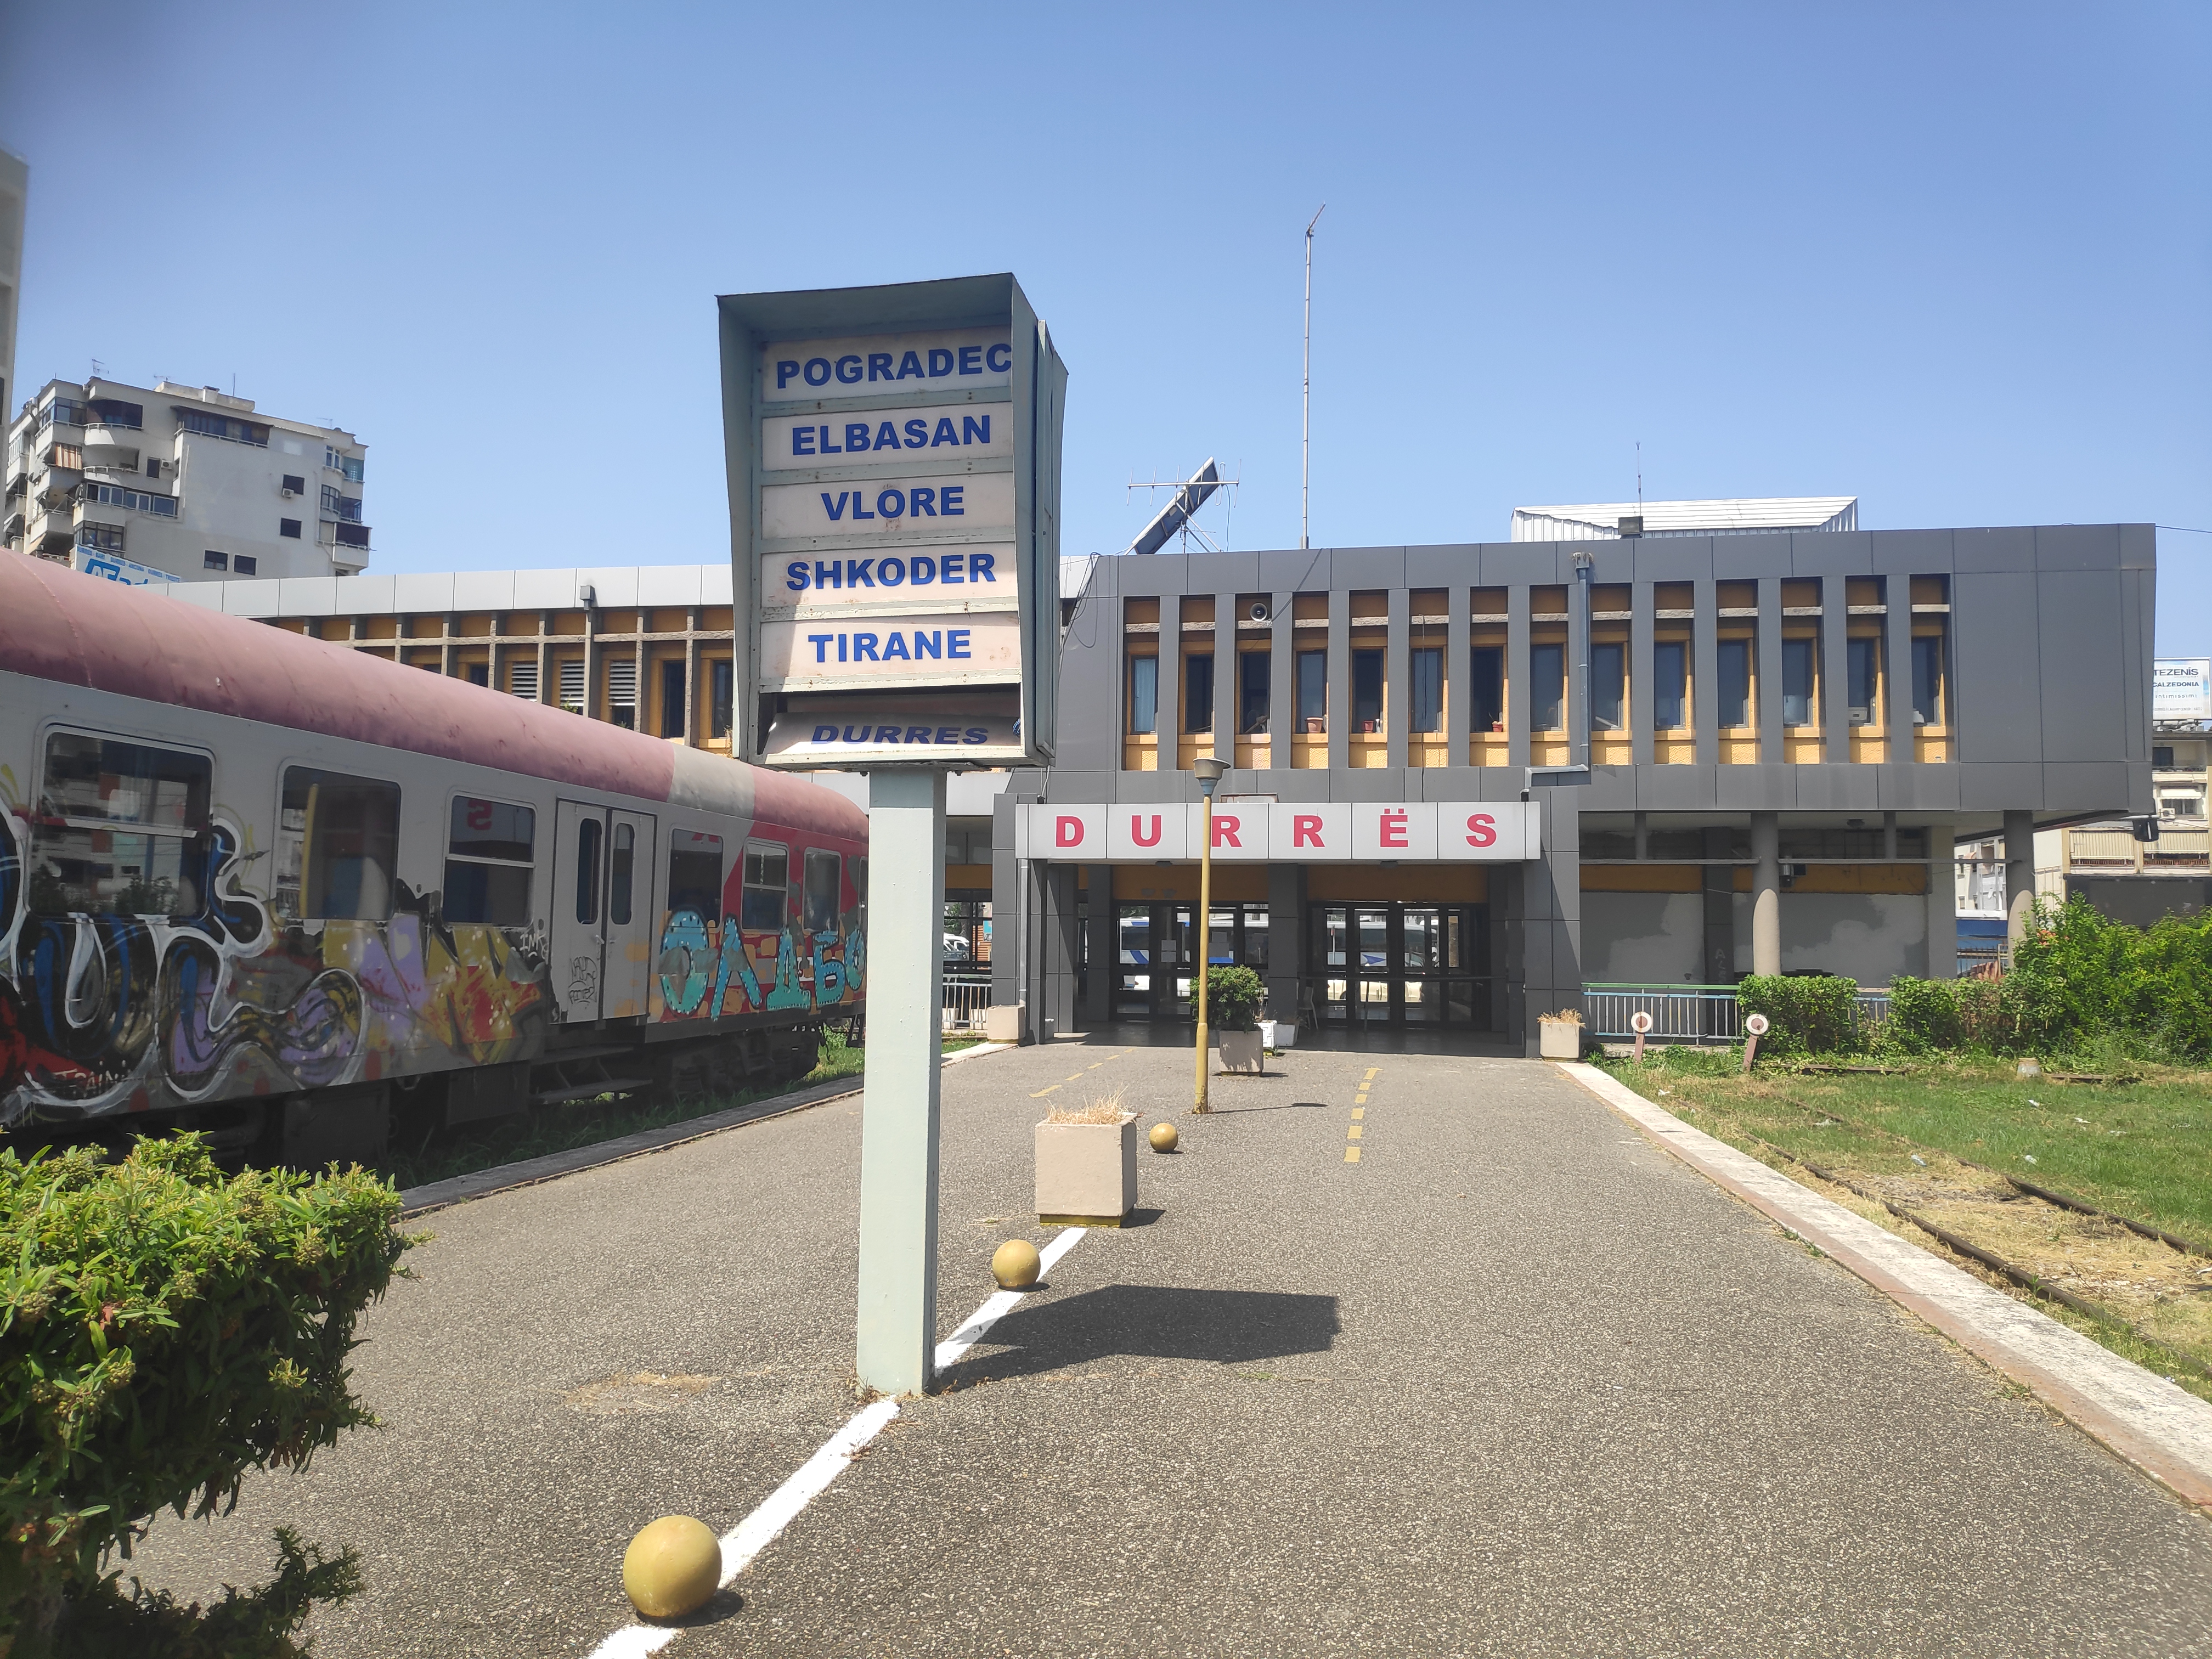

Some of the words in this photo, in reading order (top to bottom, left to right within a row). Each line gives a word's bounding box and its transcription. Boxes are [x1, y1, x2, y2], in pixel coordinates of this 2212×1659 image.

[777, 344, 1012, 389] POGRADEC
[792, 415, 991, 455] ELBASAN
[820, 486, 964, 521] VLORE
[786, 554, 996, 590] SHKODER
[808, 629, 971, 663] TIRANE
[810, 725, 989, 745] DURRES
